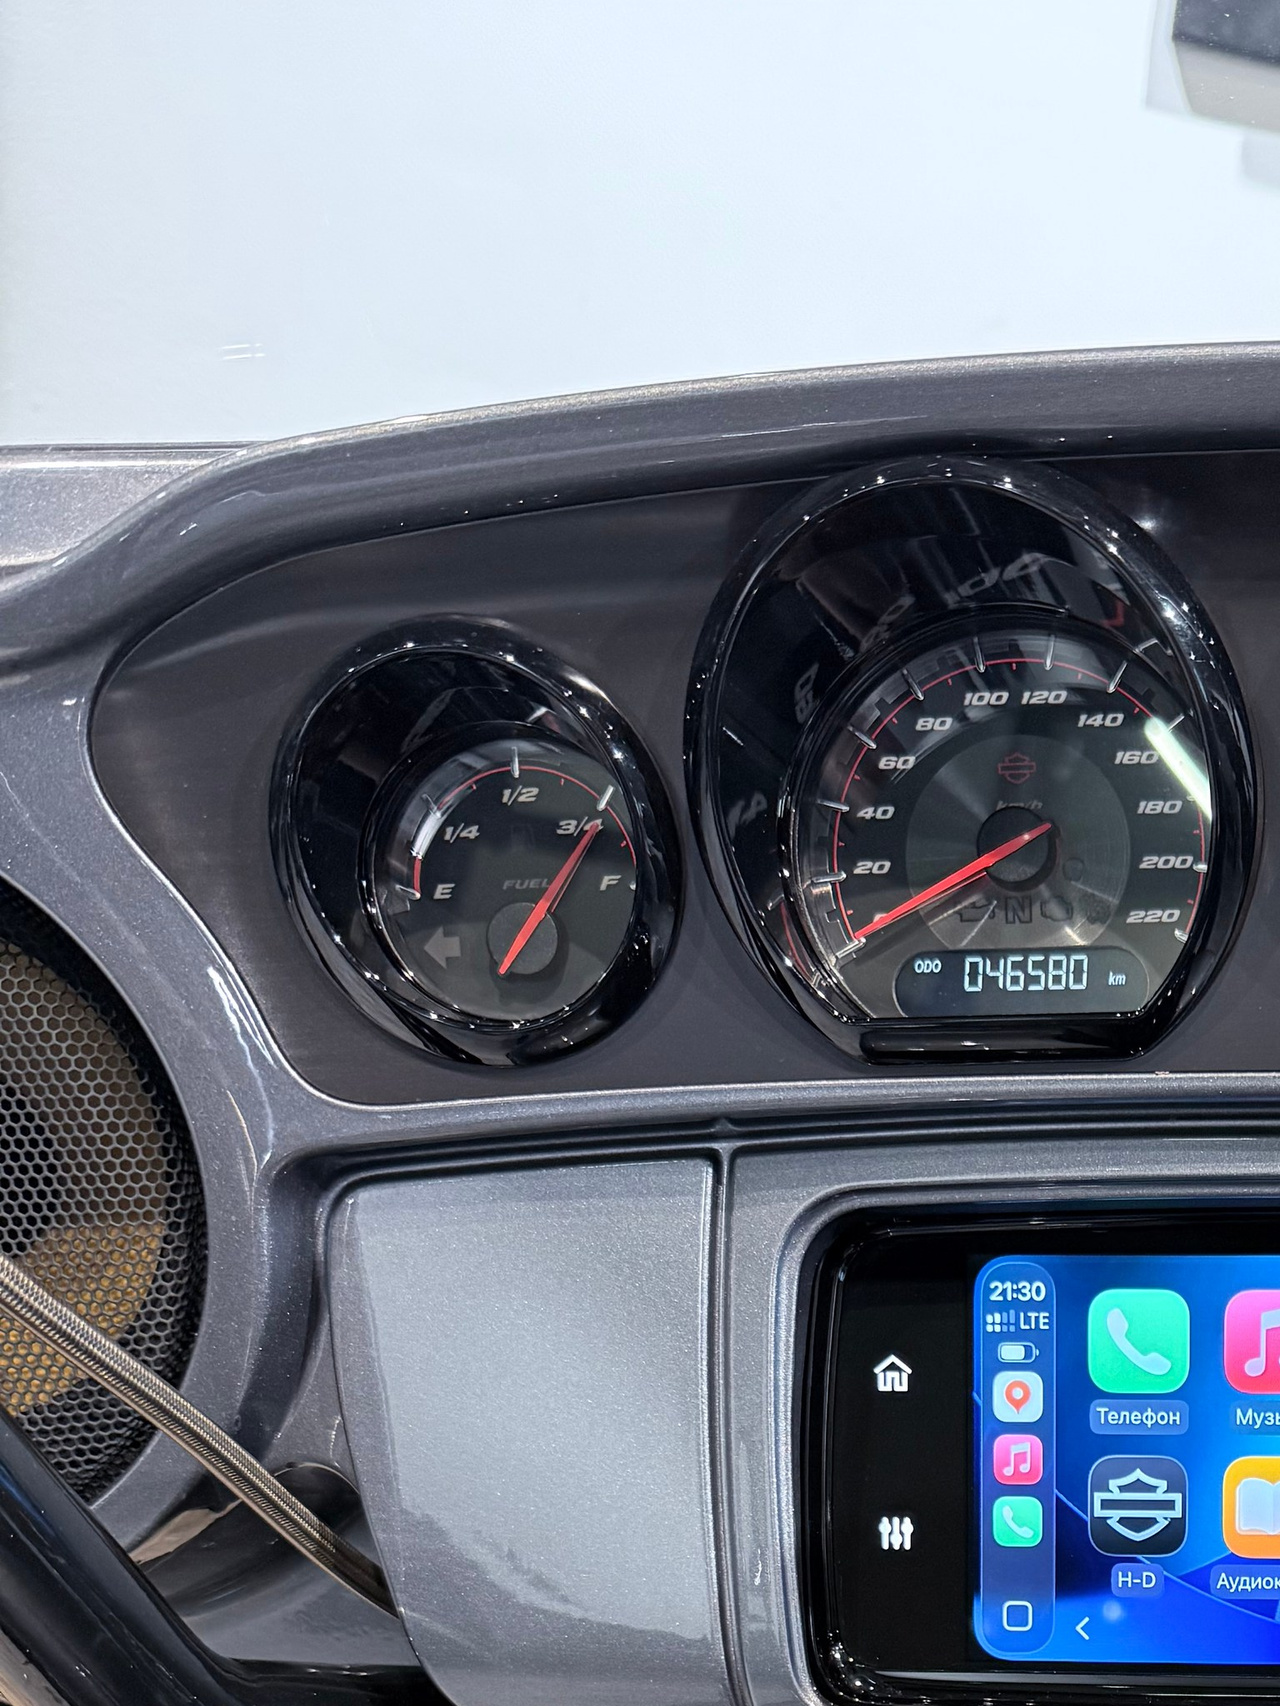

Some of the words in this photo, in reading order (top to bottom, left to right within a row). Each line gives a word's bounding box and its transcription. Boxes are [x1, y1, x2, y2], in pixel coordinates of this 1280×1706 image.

[963, 691, 1010, 707] 100
[1020, 690, 1069, 706] 120
[915, 717, 953, 732] 80
[1077, 712, 1125, 728] 140
[878, 756, 916, 770] 60
[1114, 750, 1159, 765] 160
[501, 787, 540, 806] 1/2
[856, 805, 895, 821] 40
[1137, 801, 1183, 815] 180
[443, 822, 480, 844] 1/4
[853, 860, 891, 875] 20
[1139, 855, 1195, 870] 200
[502, 878, 550, 890] FUEL
[600, 875, 622, 891] F
[433, 883, 455, 900] E
[1126, 909, 1180, 924] 220
[914, 959, 942, 974] ODO
[963, 954, 1089, 992] 046580
[1108, 972, 1126, 986] km
[988, 1281, 1046, 1302] 21:30
[1019, 1312, 1050, 1330] LTE
[1096, 1407, 1181, 1430] Телефон
[1117, 1572, 1157, 1589] H-D
